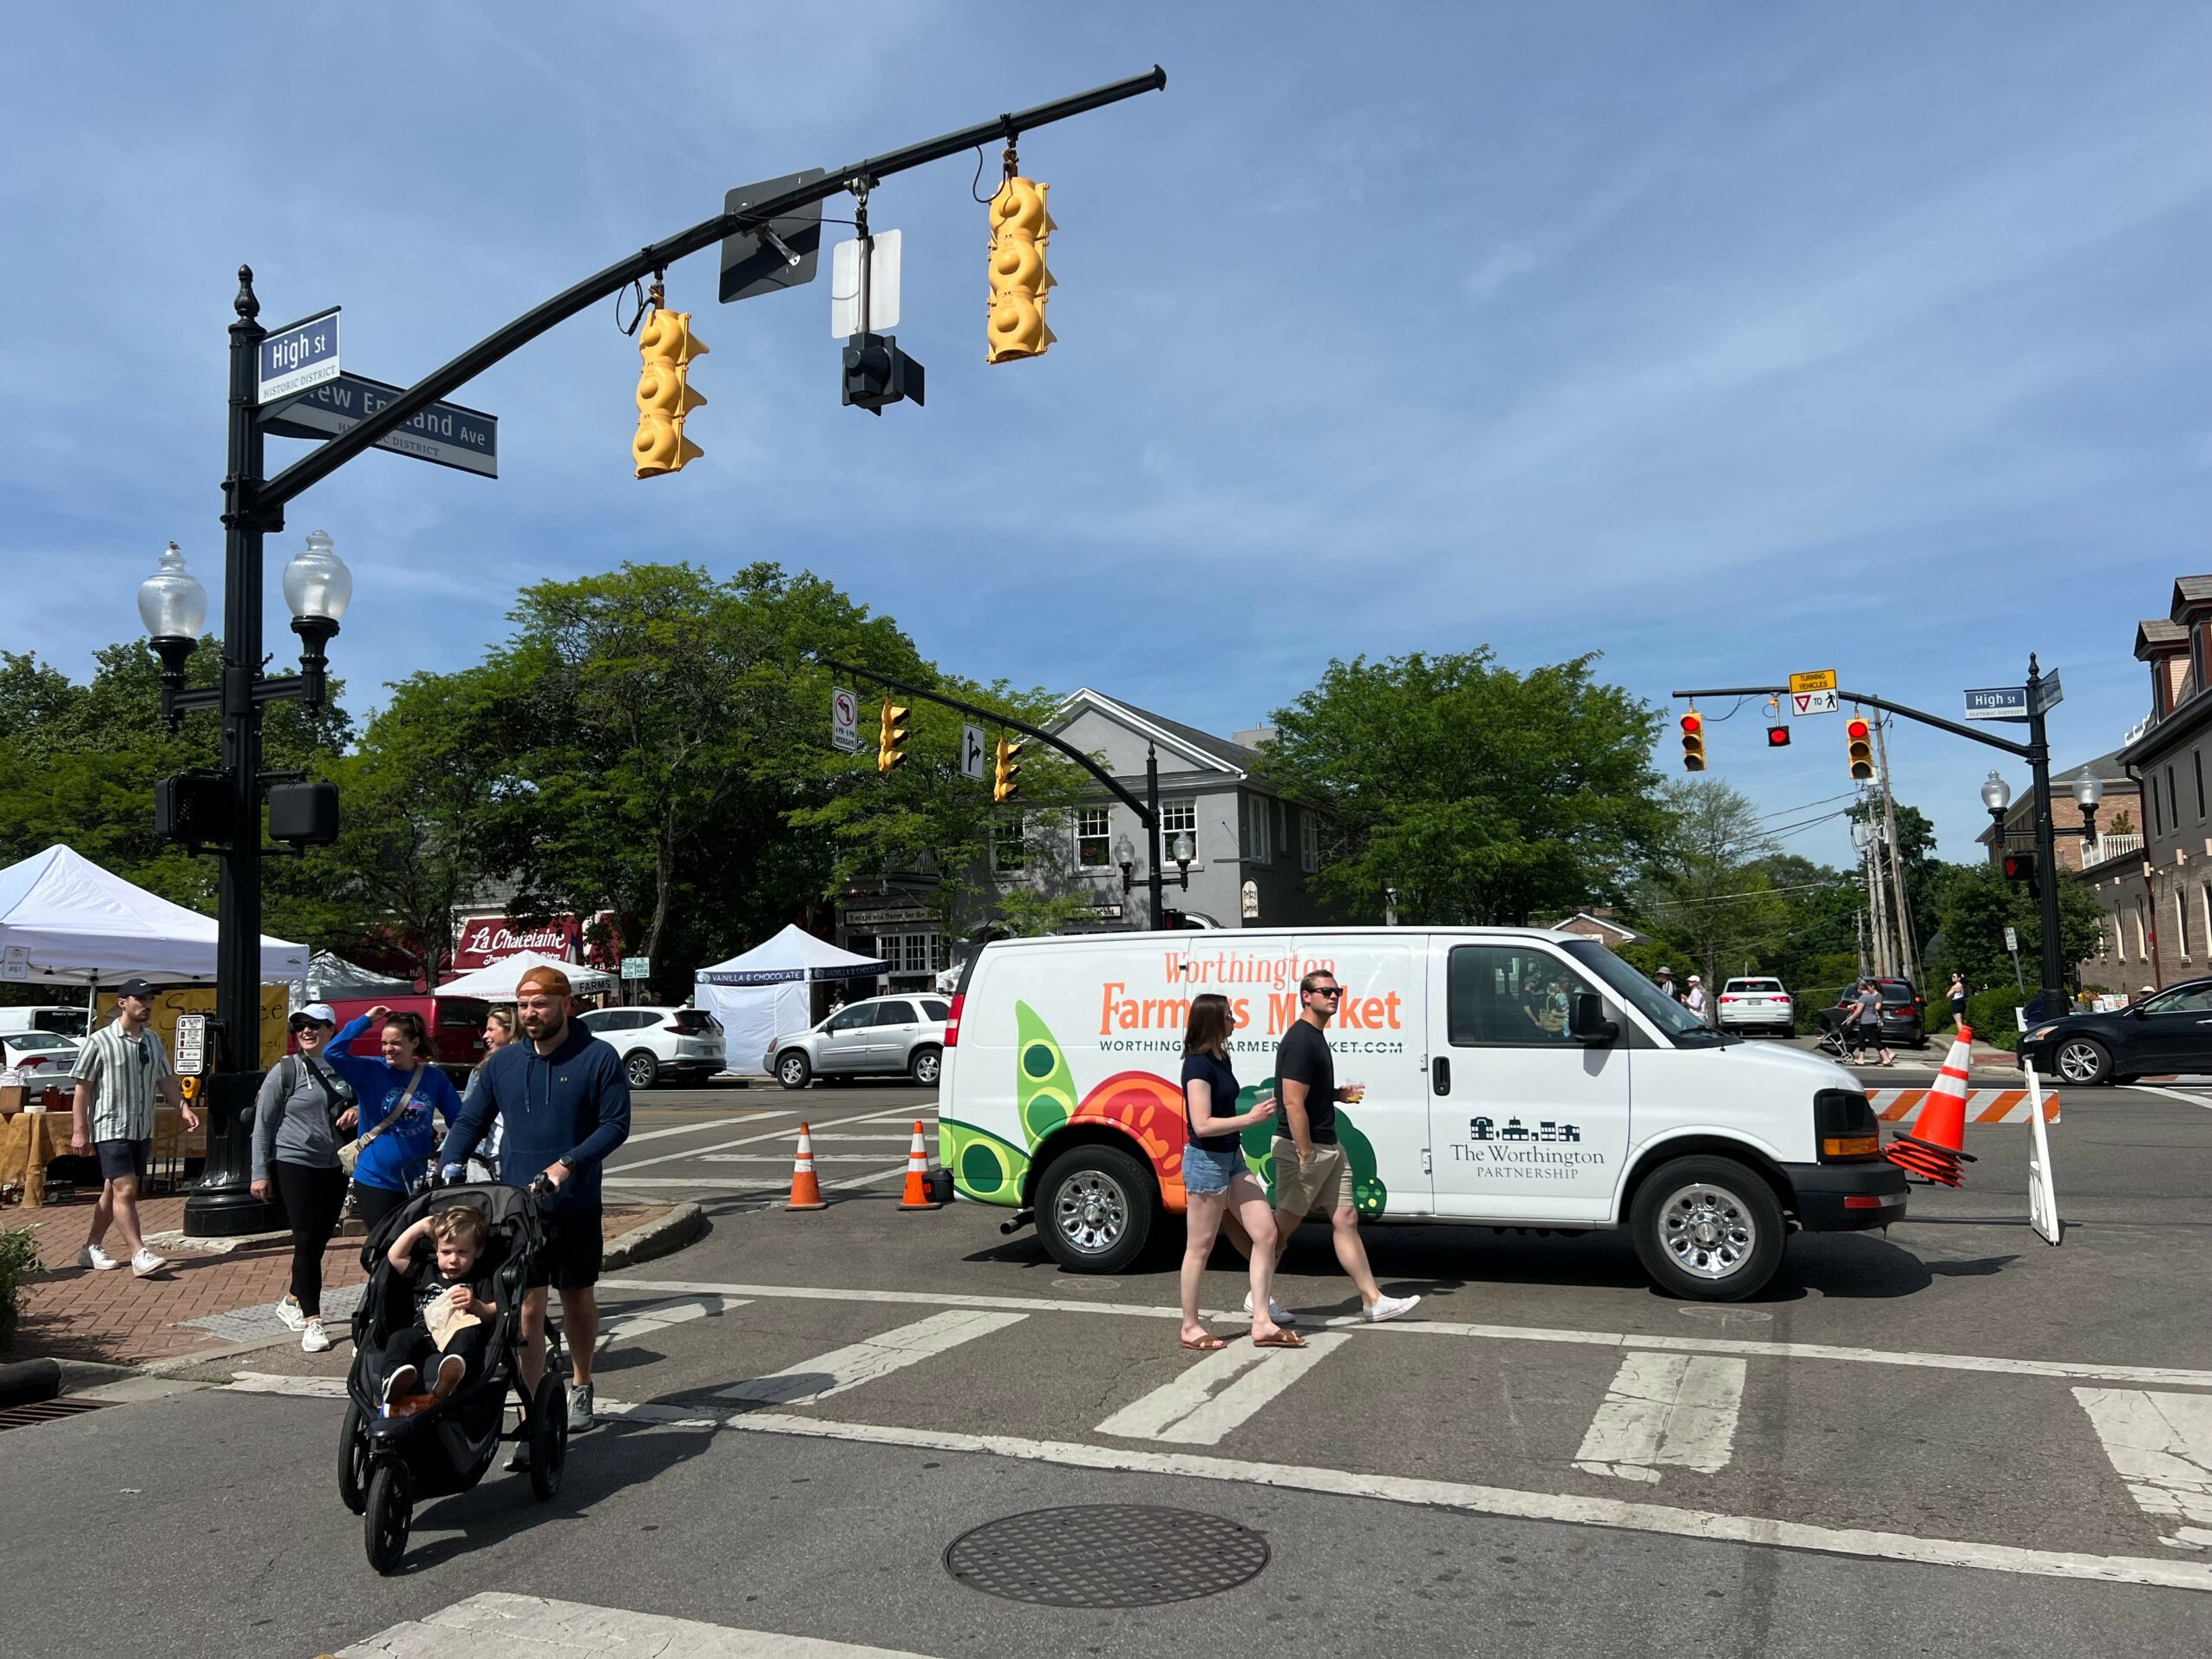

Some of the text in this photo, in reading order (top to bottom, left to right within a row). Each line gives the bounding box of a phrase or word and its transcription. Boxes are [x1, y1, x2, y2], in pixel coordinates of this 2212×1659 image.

[273, 334, 309, 369] High
[263, 364, 336, 400] HISTORIC DISTRICT
[310, 384, 351, 408] ew
[364, 392, 452, 436] Enand
[460, 426, 486, 446] Ave
[392, 436, 439, 456] DISTRICT
[1799, 673, 1826, 683] TURNING
[1799, 681, 1828, 690] VEHICLES
[1813, 697, 1823, 706] TO
[1975, 694, 2003, 708] High
[465, 926, 493, 953] La
[753, 972, 800, 981] CHOCOLATE
[579, 979, 611, 993] FARMS
[1450, 1144, 1605, 1167] The Worthington
[1477, 1166, 1579, 1179] PARTNERSHIP
